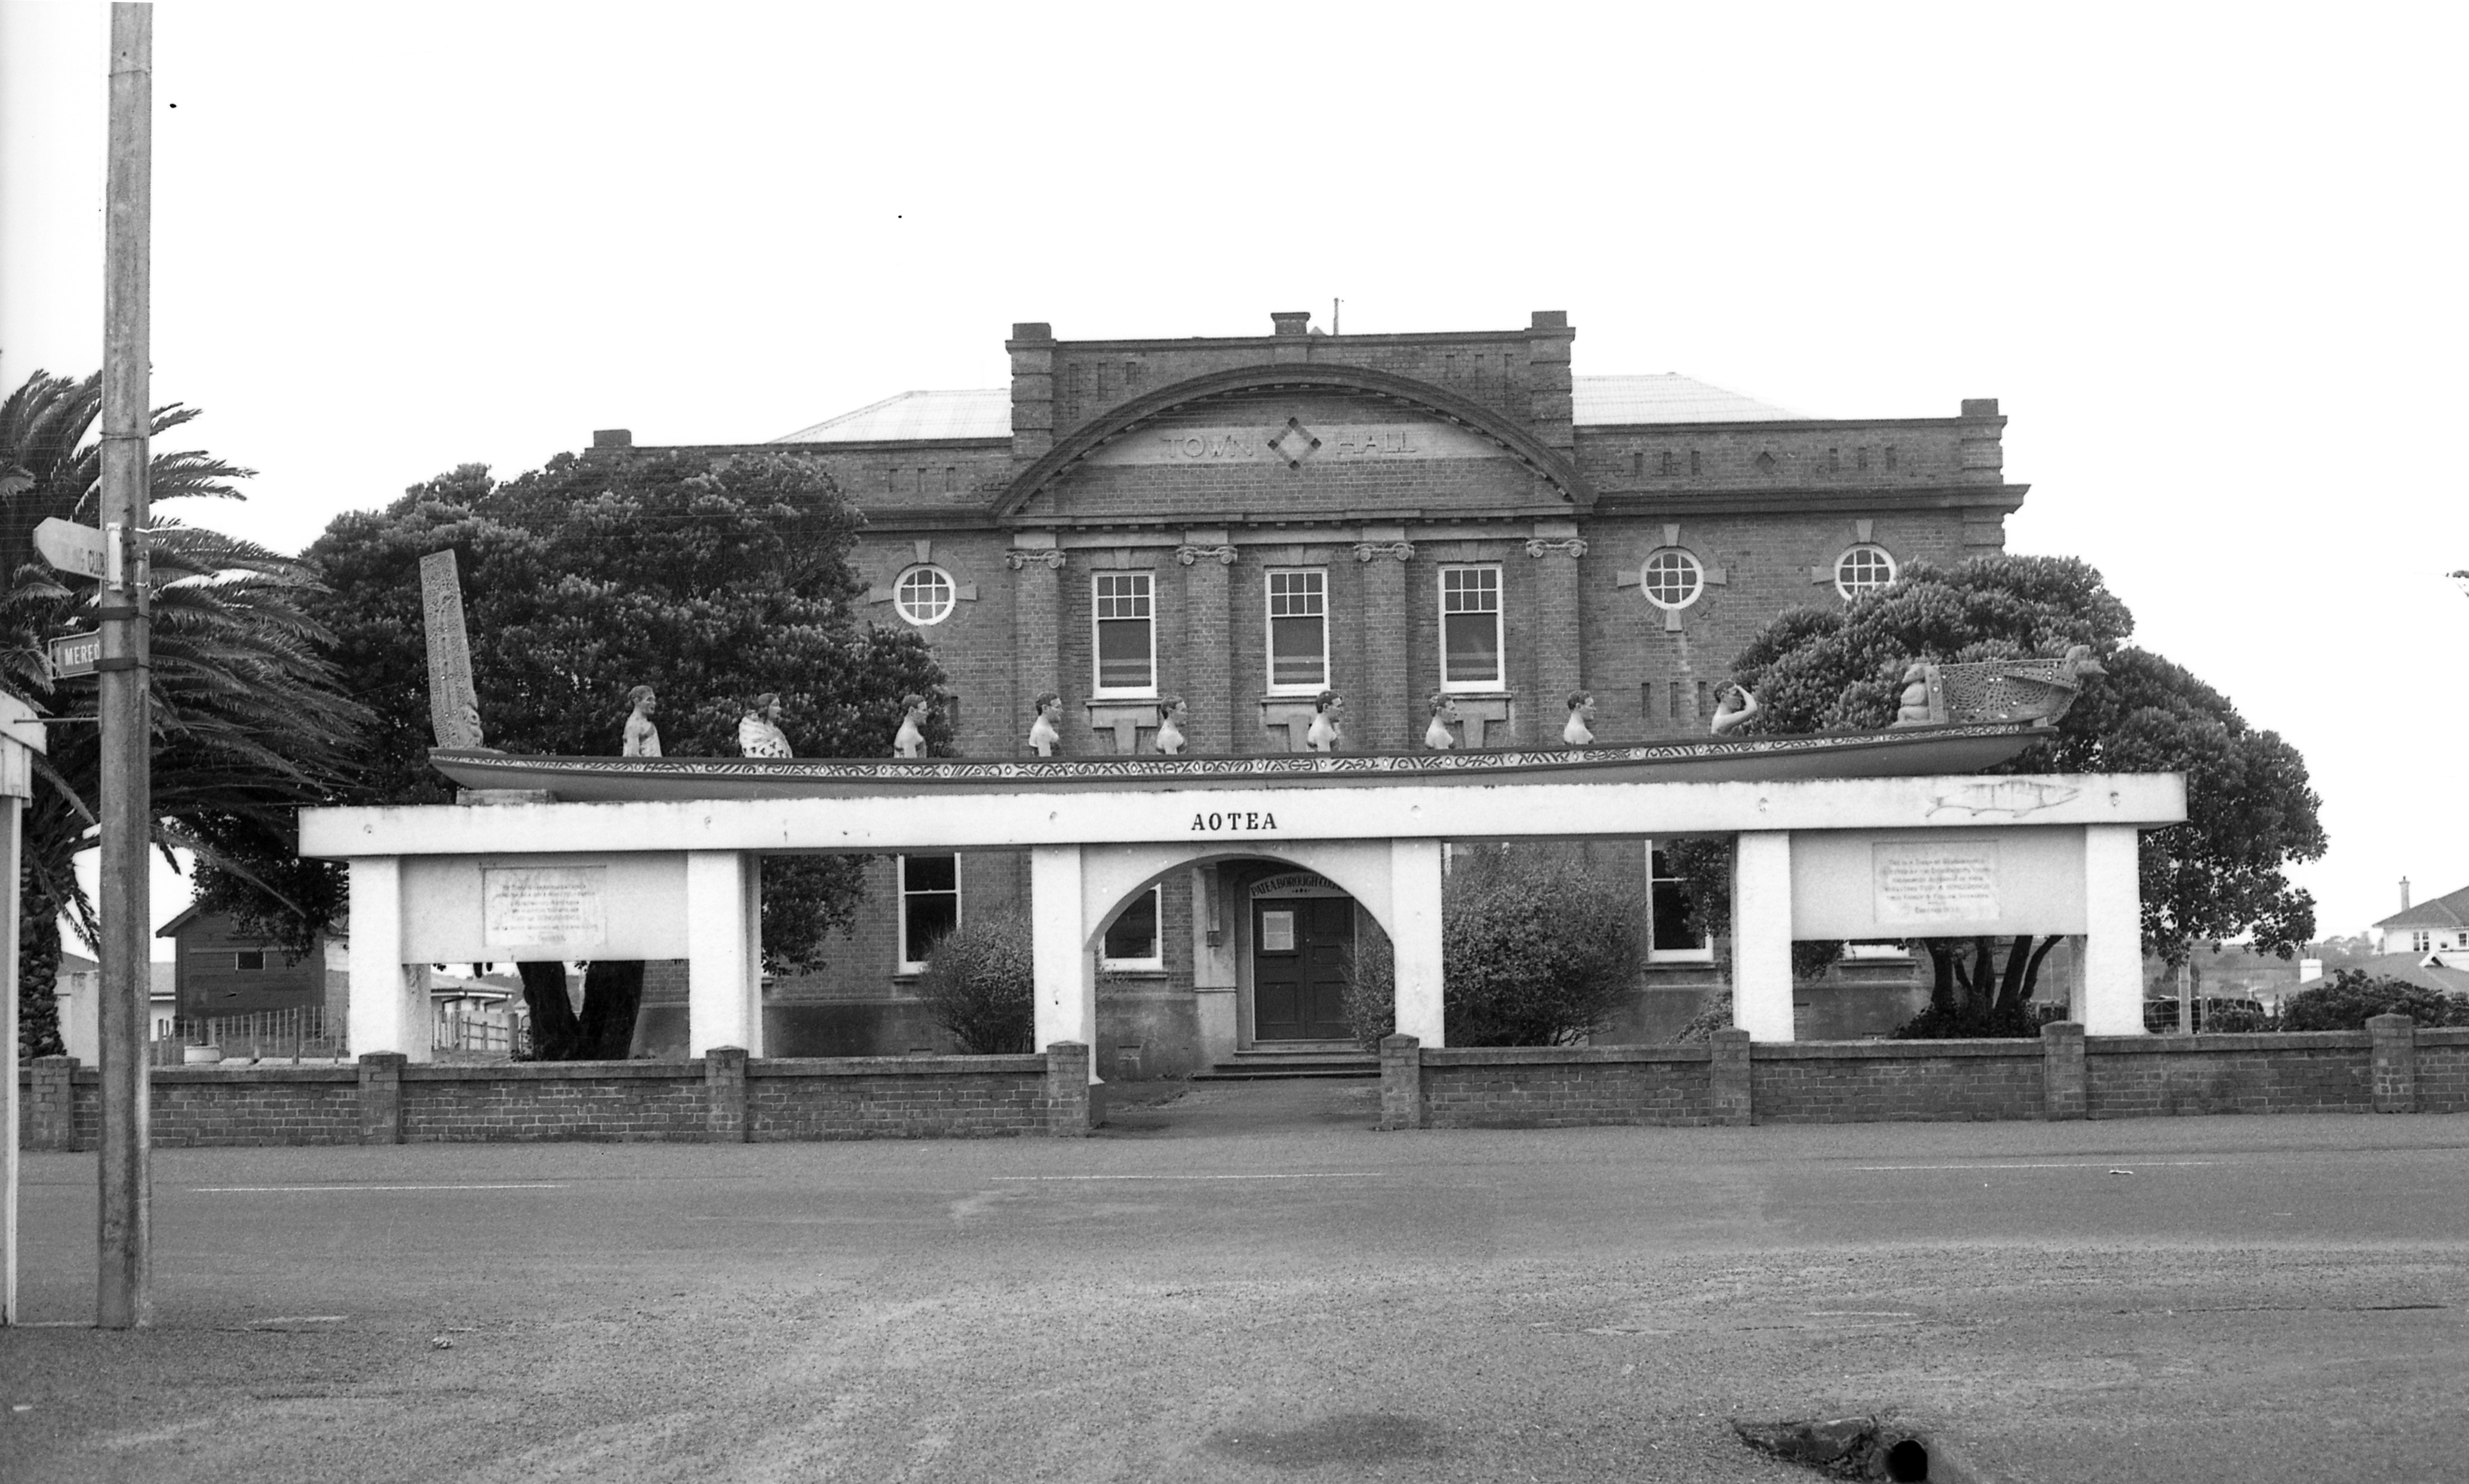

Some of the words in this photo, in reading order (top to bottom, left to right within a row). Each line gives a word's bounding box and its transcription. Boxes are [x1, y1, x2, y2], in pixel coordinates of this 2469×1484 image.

[1160, 434, 1254, 457] TOWN
[1337, 431, 1417, 454] HALL
[65, 643, 100, 666] MERED
[1191, 813, 1278, 831] AOTEA
[1251, 880, 1277, 897] PATEA
[1276, 875, 1318, 889] BOROUGH
